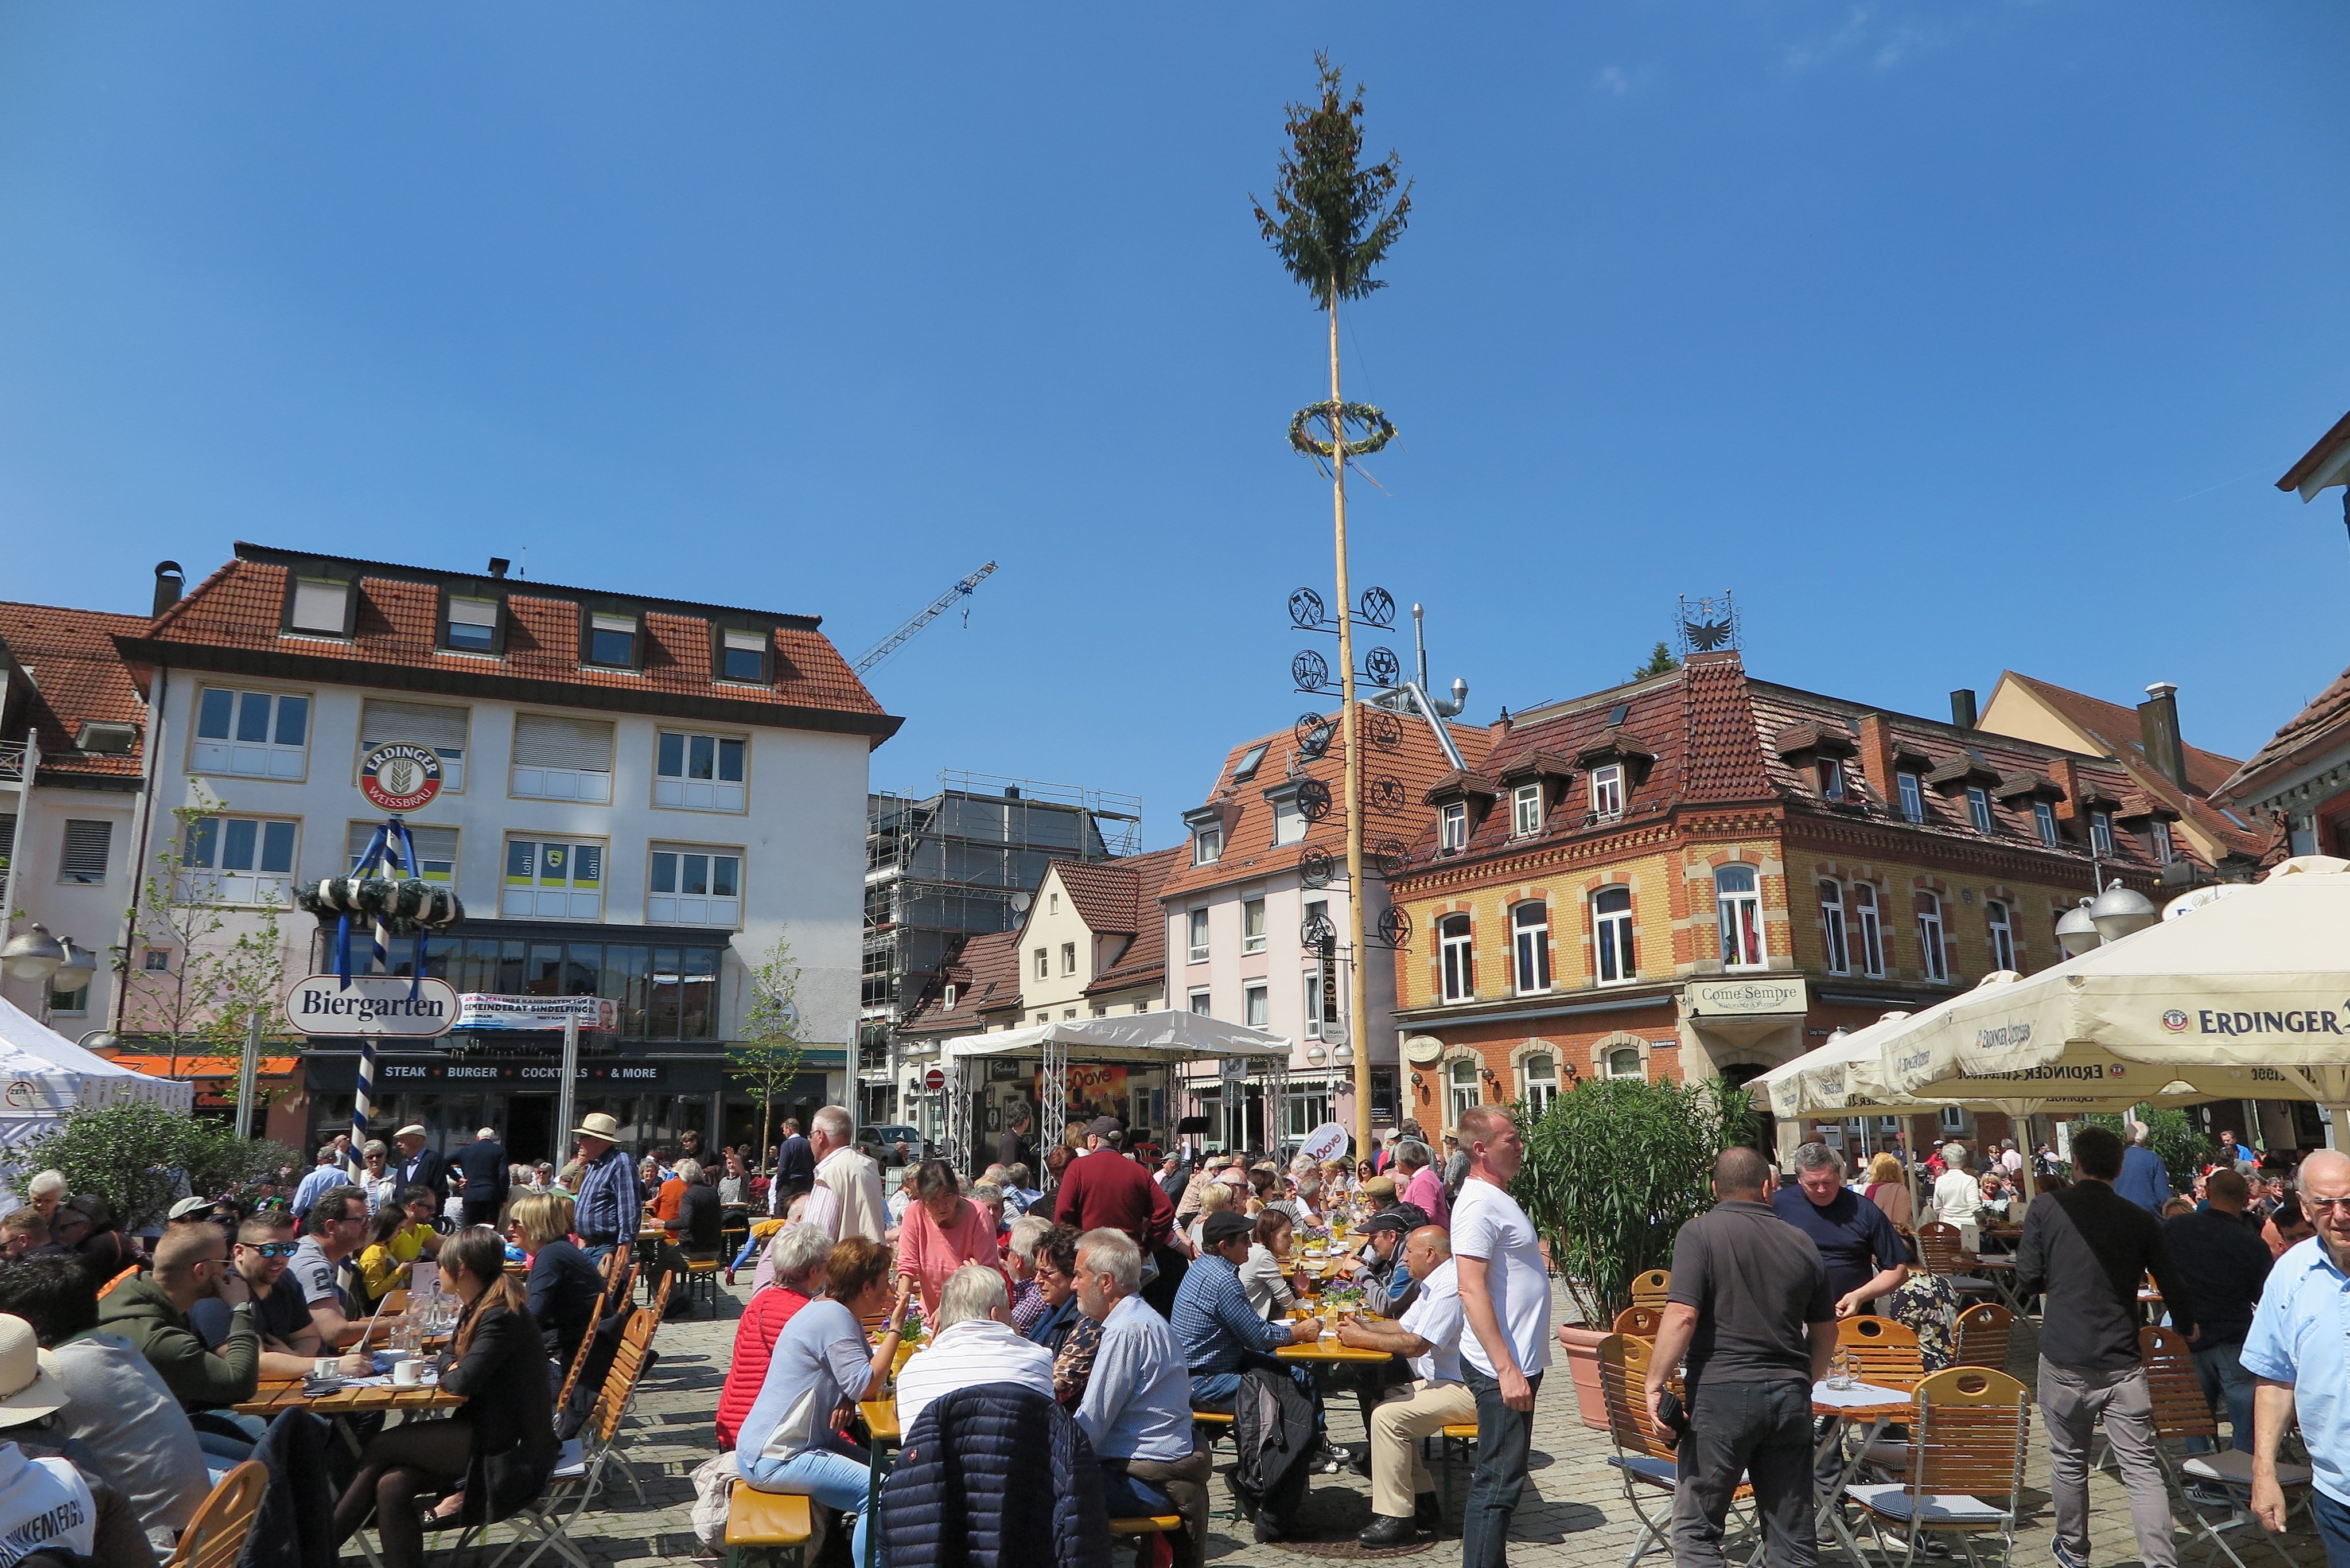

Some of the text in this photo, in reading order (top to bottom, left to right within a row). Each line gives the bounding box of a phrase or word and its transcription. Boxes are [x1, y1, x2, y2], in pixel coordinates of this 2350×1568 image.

[366, 746, 438, 775] ERDINGER
[1702, 986, 1797, 1002] Come Sempre
[299, 990, 444, 1022] Biergarten
[464, 1003, 528, 1012] GEMEINDERAT
[2198, 1010, 2344, 1036] ERDINGER
[385, 1067, 657, 1079] STEAK BURGER COCKTLS & MORE
